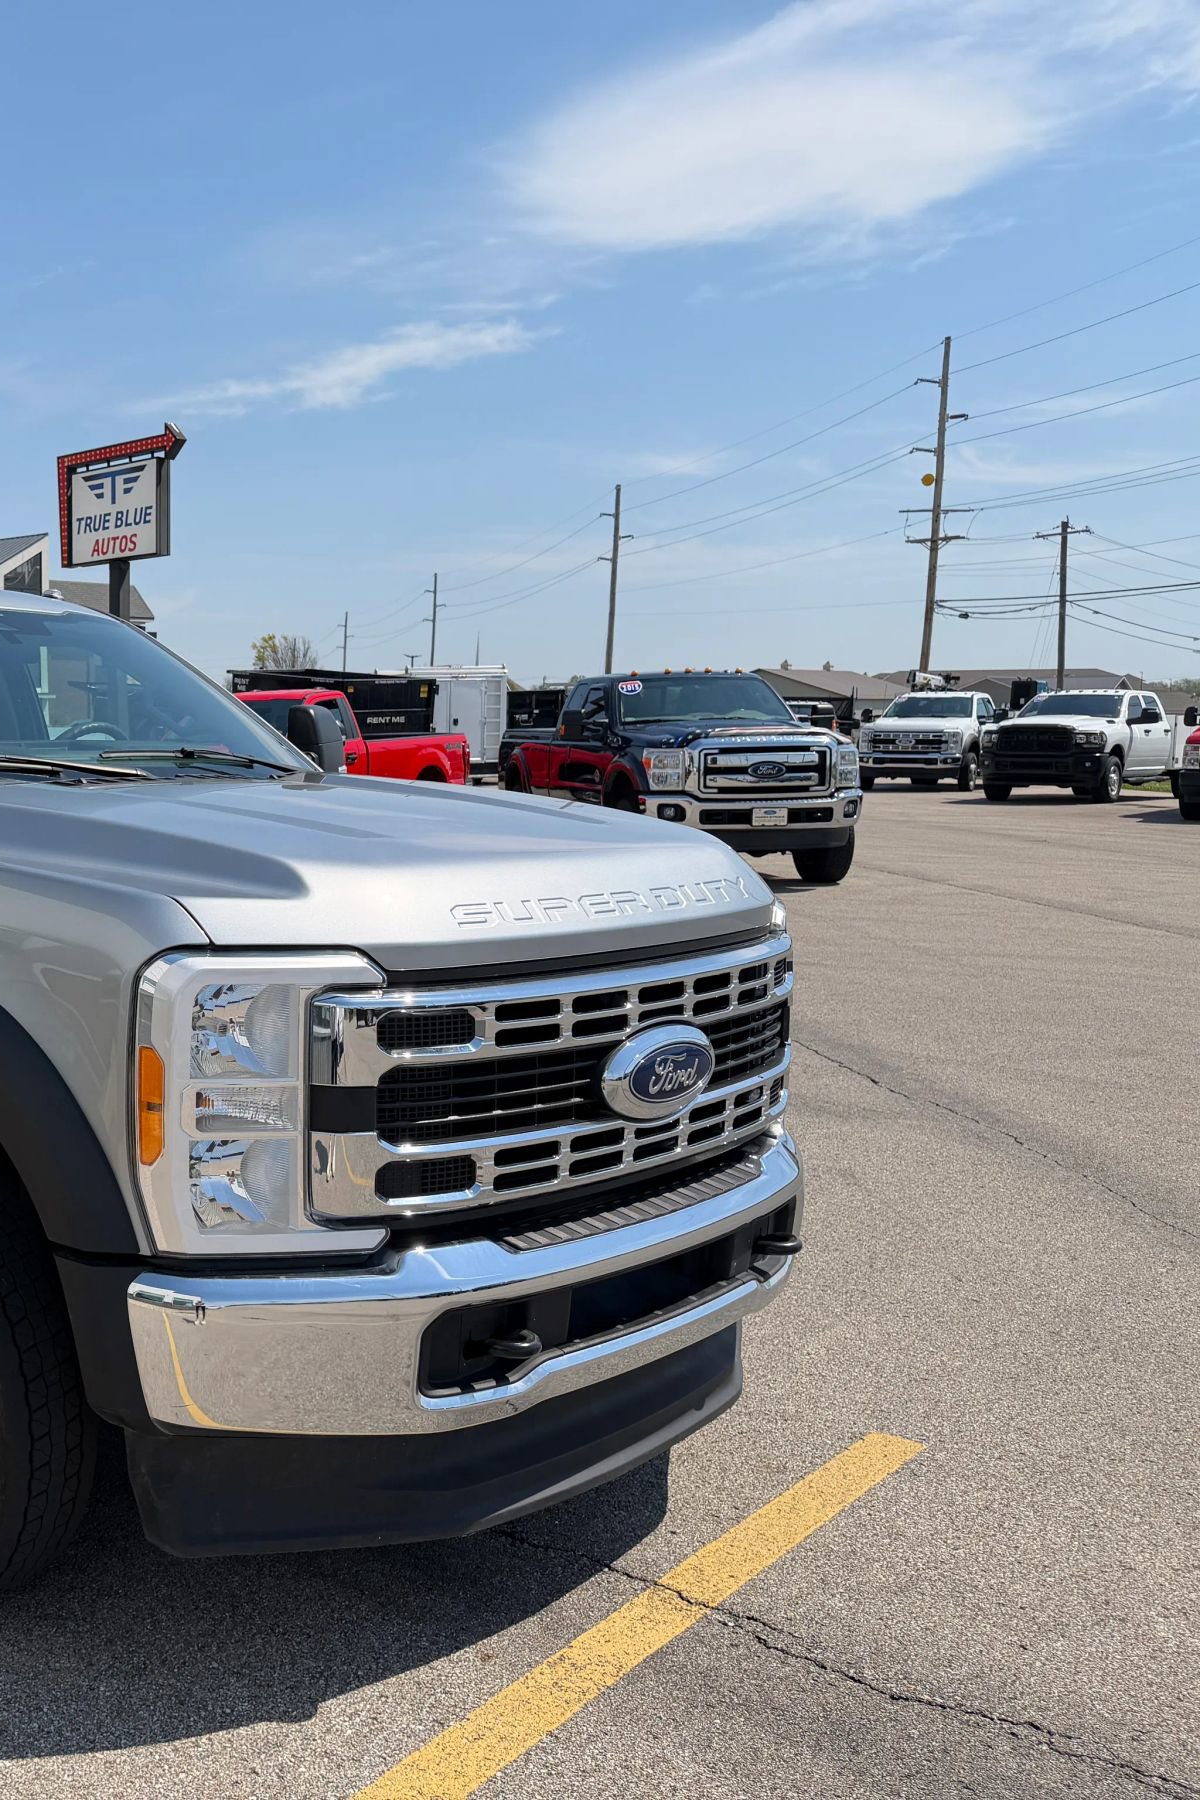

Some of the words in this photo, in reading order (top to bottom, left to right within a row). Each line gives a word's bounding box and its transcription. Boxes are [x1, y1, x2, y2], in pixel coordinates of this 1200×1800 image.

[76, 512, 111, 535] TRUE
[114, 505, 153, 529] BLUE
[90, 533, 138, 557] AUTOS
[367, 715, 391, 724] RENT
[392, 715, 406, 723] ME
[757, 765, 778, 775] Ford
[449, 892, 653, 930] SUPER
[648, 875, 750, 912] DUTY
[649, 1052, 699, 1095] Ford
